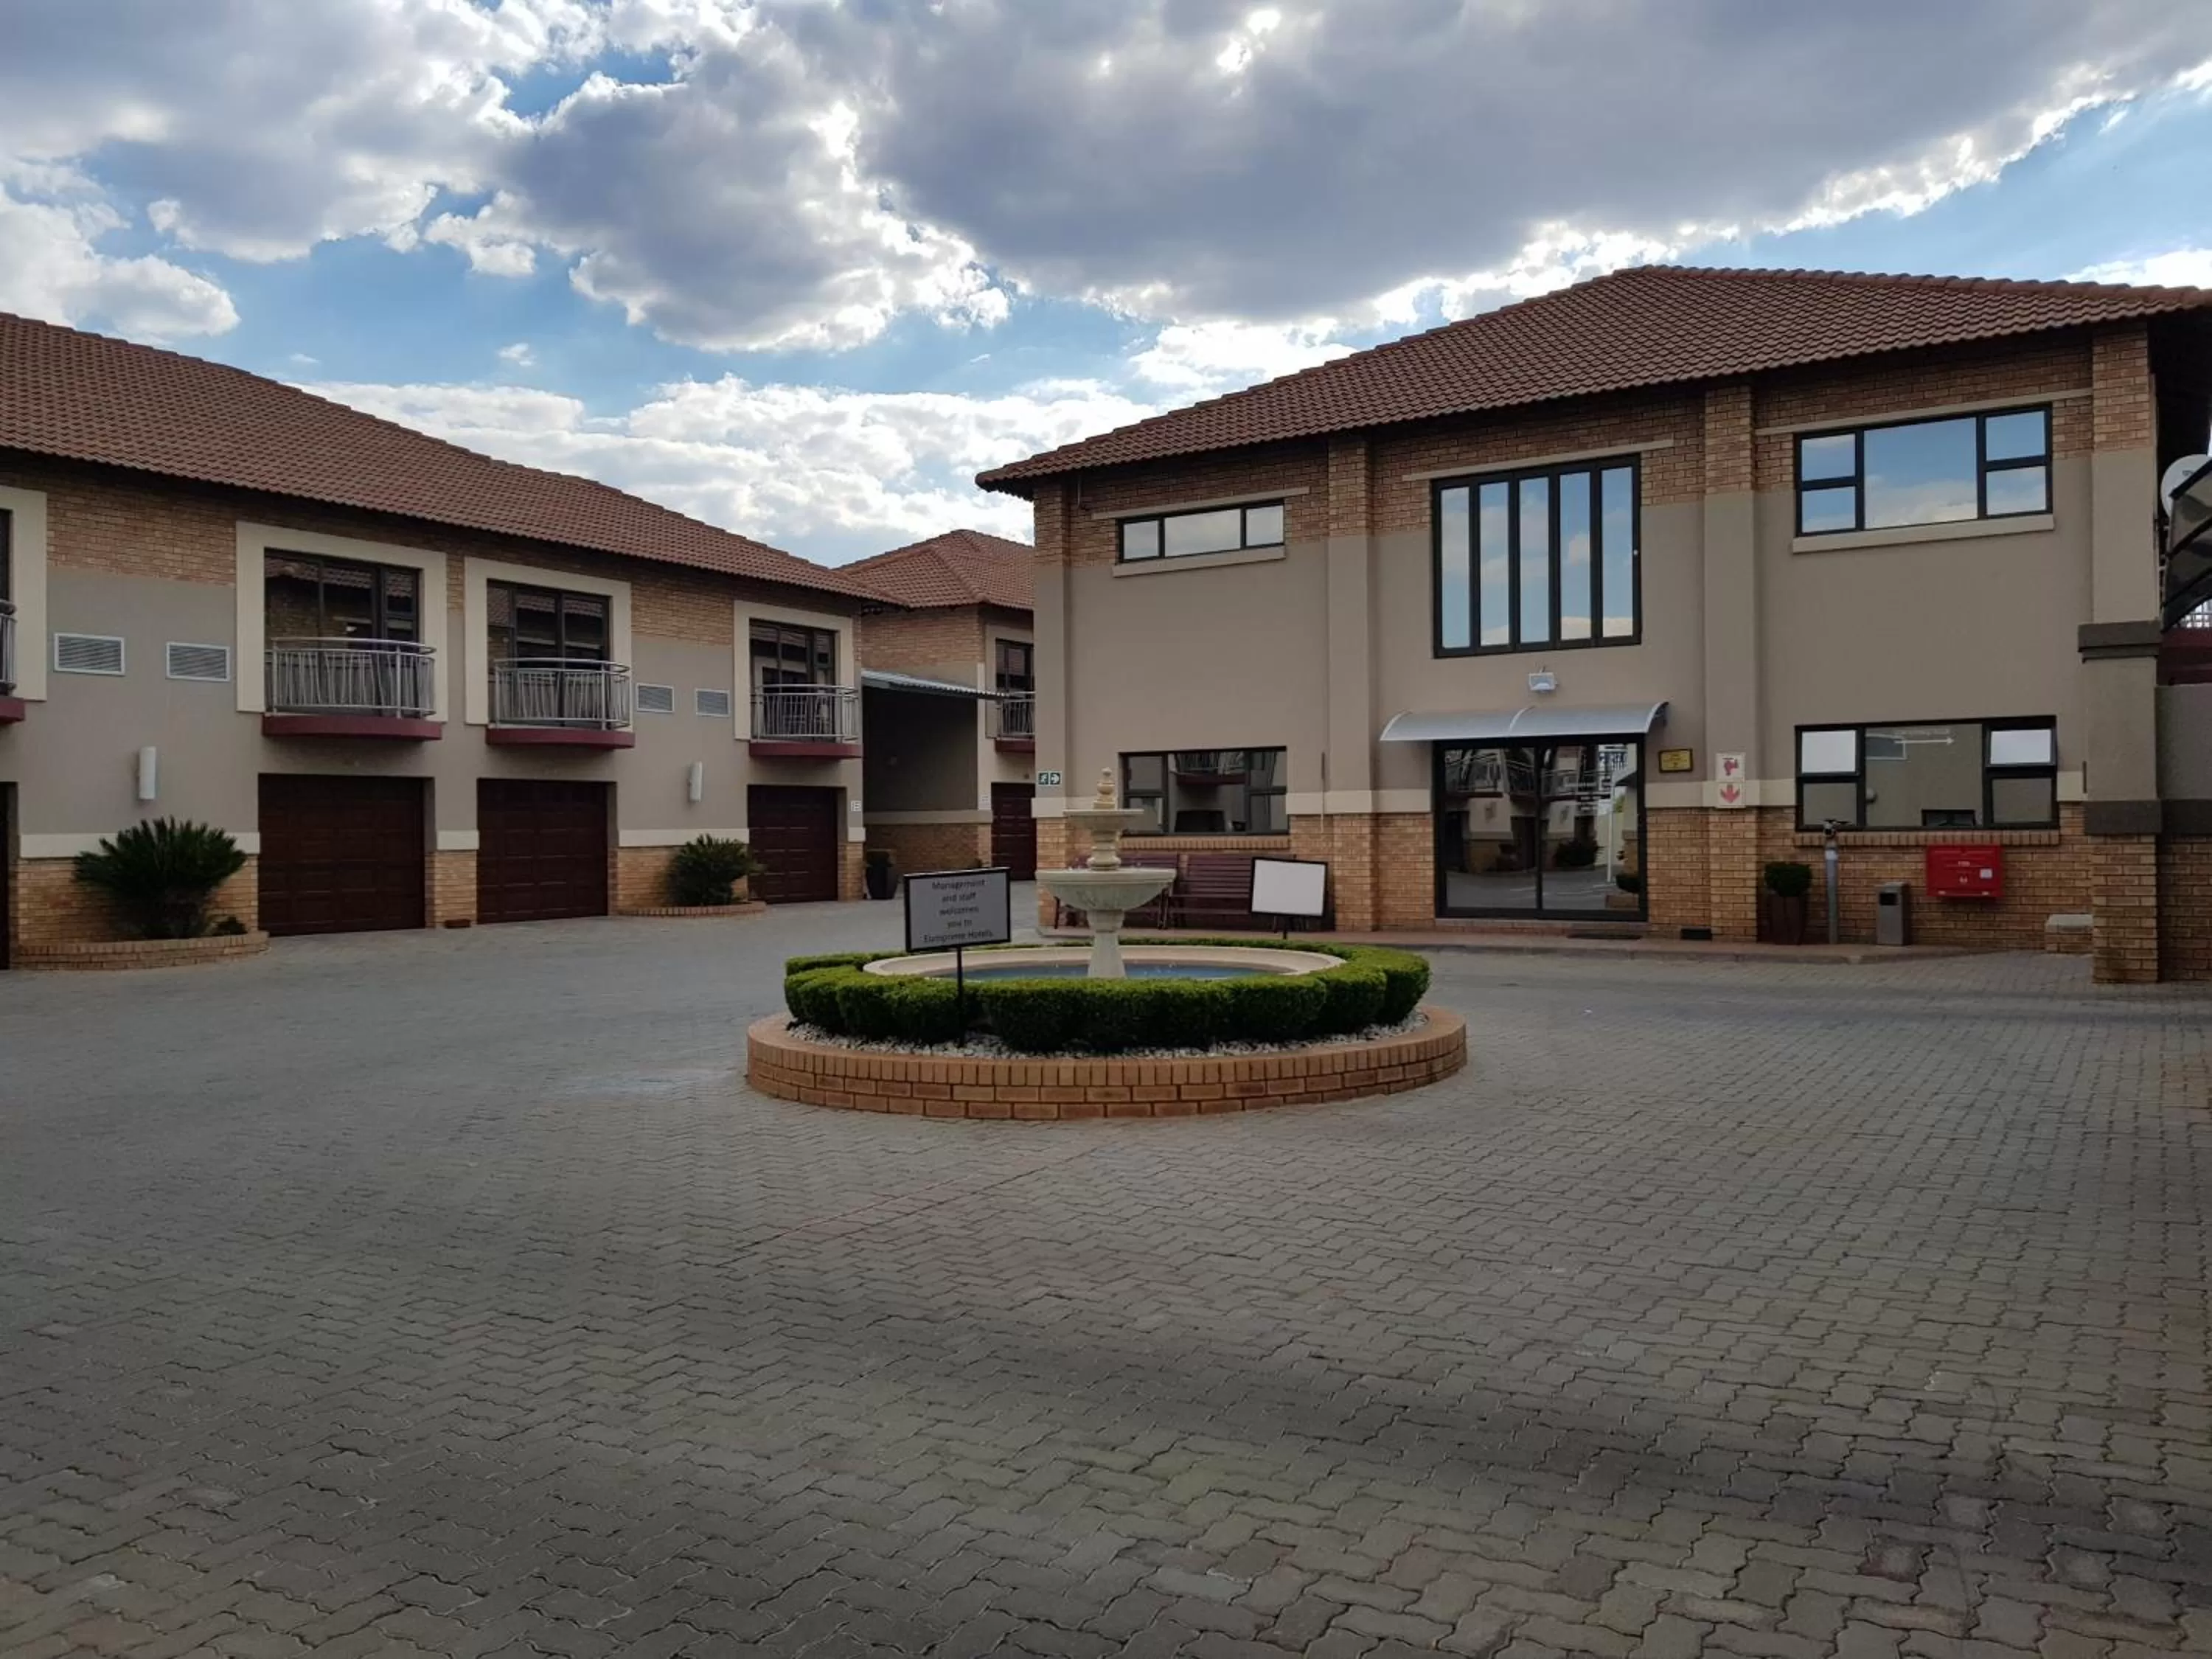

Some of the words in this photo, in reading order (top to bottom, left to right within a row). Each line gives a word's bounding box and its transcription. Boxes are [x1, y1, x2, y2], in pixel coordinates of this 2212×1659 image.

[932, 879, 985, 891] Management
[942, 894, 957, 902] and
[959, 891, 976, 901] staff
[947, 921, 961, 929] you
